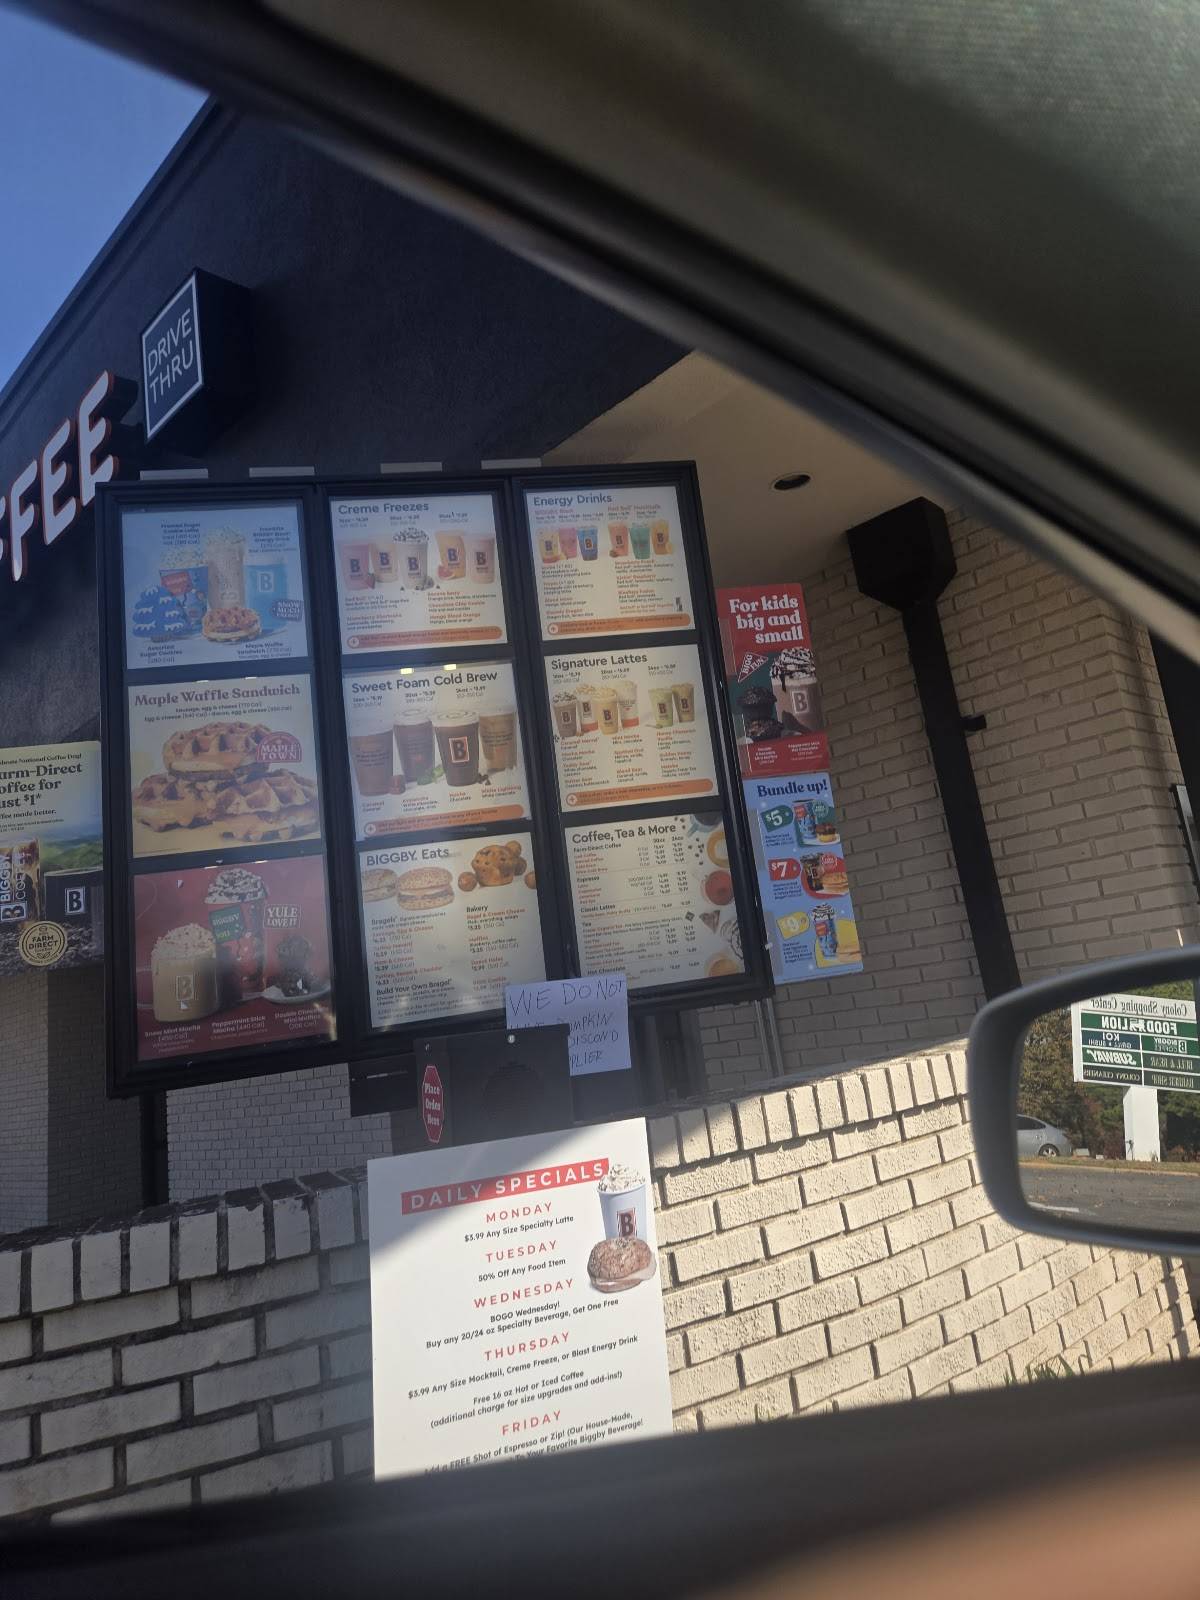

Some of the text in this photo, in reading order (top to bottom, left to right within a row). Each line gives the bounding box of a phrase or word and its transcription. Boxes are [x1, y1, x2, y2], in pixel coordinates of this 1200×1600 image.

[148, 307, 193, 377] DRIVE
[149, 340, 194, 404] THRU
[0, 369, 117, 582] FEE
[338, 503, 430, 515] Creme Freezes
[533, 493, 613, 507] Energy Drinks
[259, 573, 273, 591] B
[729, 594, 799, 614] For kids
[736, 609, 802, 631] big and
[755, 626, 804, 644] small
[551, 654, 648, 671] Signature Lattes
[352, 671, 498, 694] Sweet Foam Cold Brew
[134, 683, 300, 708] Maple Waffle Sandwich
[794, 692, 808, 712] B
[260, 742, 300, 753] MAPLE
[261, 751, 297, 760] TOWN
[452, 739, 467, 761] B
[39, 778, 62, 791] for
[757, 779, 828, 798] Bundle up!
[765, 809, 783, 826] $5
[572, 824, 676, 844] Coffee, Tea & More
[421, 847, 450, 860] Eats
[0, 853, 11, 902] BIGGBY
[771, 861, 788, 878] $7
[68, 890, 82, 912] B
[267, 906, 298, 918] YULE
[267, 918, 298, 927] LOVE IT
[28, 940, 59, 950] DIRECT
[32, 934, 54, 942] FARM
[509, 988, 551, 1016] WE
[562, 983, 592, 1005] DO
[424, 1082, 440, 1095] Place
[425, 1098, 441, 1110] Order
[411, 1163, 604, 1209] DAILY SPECIALS
[486, 1202, 552, 1223] MONDAY
[486, 1229, 500, 1239] Any
[502, 1226, 518, 1235] Size
[520, 1219, 554, 1233] Specialty
[555, 1215, 574, 1225] Latte
[619, 1212, 634, 1237] B
[486, 1240, 557, 1263] TUESDAY
[478, 1258, 566, 1282] 50% Off Any Food Item
[473, 1278, 573, 1308] WEDNESDAY
[490, 1301, 560, 1323] BOGO Wednesday!
[426, 1299, 619, 1349] Buy any 20/24 oz Specialty Beverage, Get One Free
[484, 1332, 569, 1361] THURSDAY
[432, 1383, 448, 1393] Any
[450, 1379, 467, 1389] Size
[468, 1368, 505, 1383] Mocktail,
[506, 1363, 531, 1375] Creme
[533, 1356, 560, 1367] Freeze,
[572, 1347, 590, 1358] Blast
[592, 1341, 617, 1353] Energy
[618, 1335, 638, 1346] Drink
[473, 1395, 491, 1405] Free
[492, 1391, 502, 1400] 16
[503, 1389, 513, 1397] oz
[515, 1384, 529, 1393] Hot
[541, 1376, 559, 1387] Iced
[560, 1371, 584, 1382] Coffee
[430, 1370, 623, 1429] (additional charge for size upgrades and add-ins!)
[502, 1410, 561, 1436] FRIDAY
[450, 1457, 471, 1471] FREE
[473, 1451, 492, 1465] Shot
[493, 1446, 502, 1457] of
[503, 1440, 538, 1455] Espresso
[550, 1431, 565, 1442] Zip!
[567, 1426, 584, 1437] (Our
[585, 1412, 633, 1432] House-Made,
[546, 1439, 578, 1453] Favorite
[579, 1430, 606, 1446] Biggby
[607, 1417, 644, 1435] Beverage!
